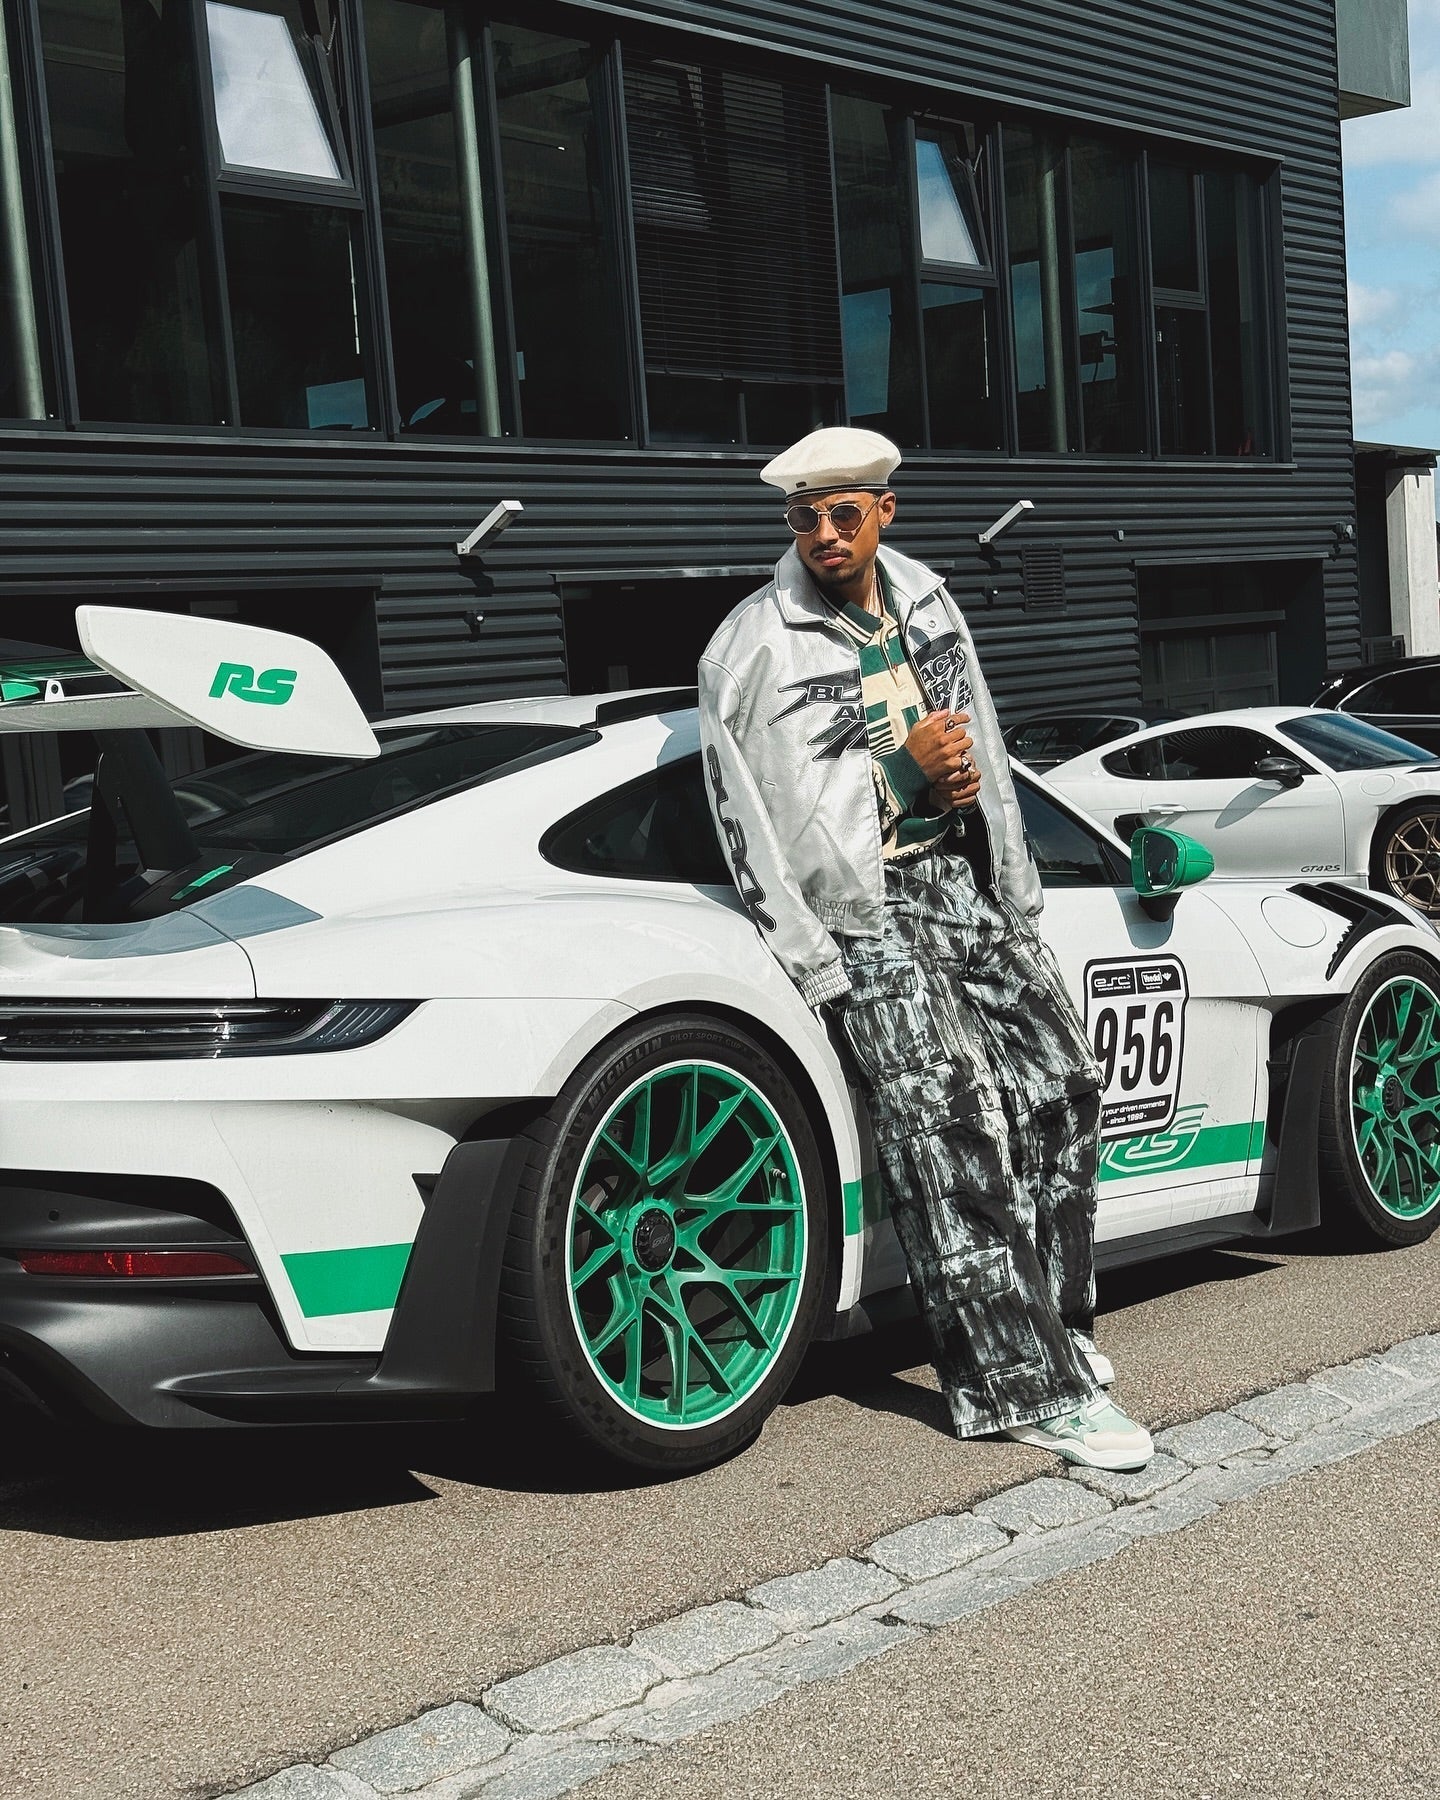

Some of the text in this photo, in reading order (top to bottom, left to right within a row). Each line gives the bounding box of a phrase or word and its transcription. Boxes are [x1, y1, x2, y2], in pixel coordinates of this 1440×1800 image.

[208, 661, 298, 705] RS
[670, 1032, 694, 1043] PILOT
[1093, 1000, 1174, 1094] 956
[588, 1037, 663, 1111] MICHELIN
[1105, 1107, 1119, 1117] your
[1120, 1104, 1138, 1114] driven
